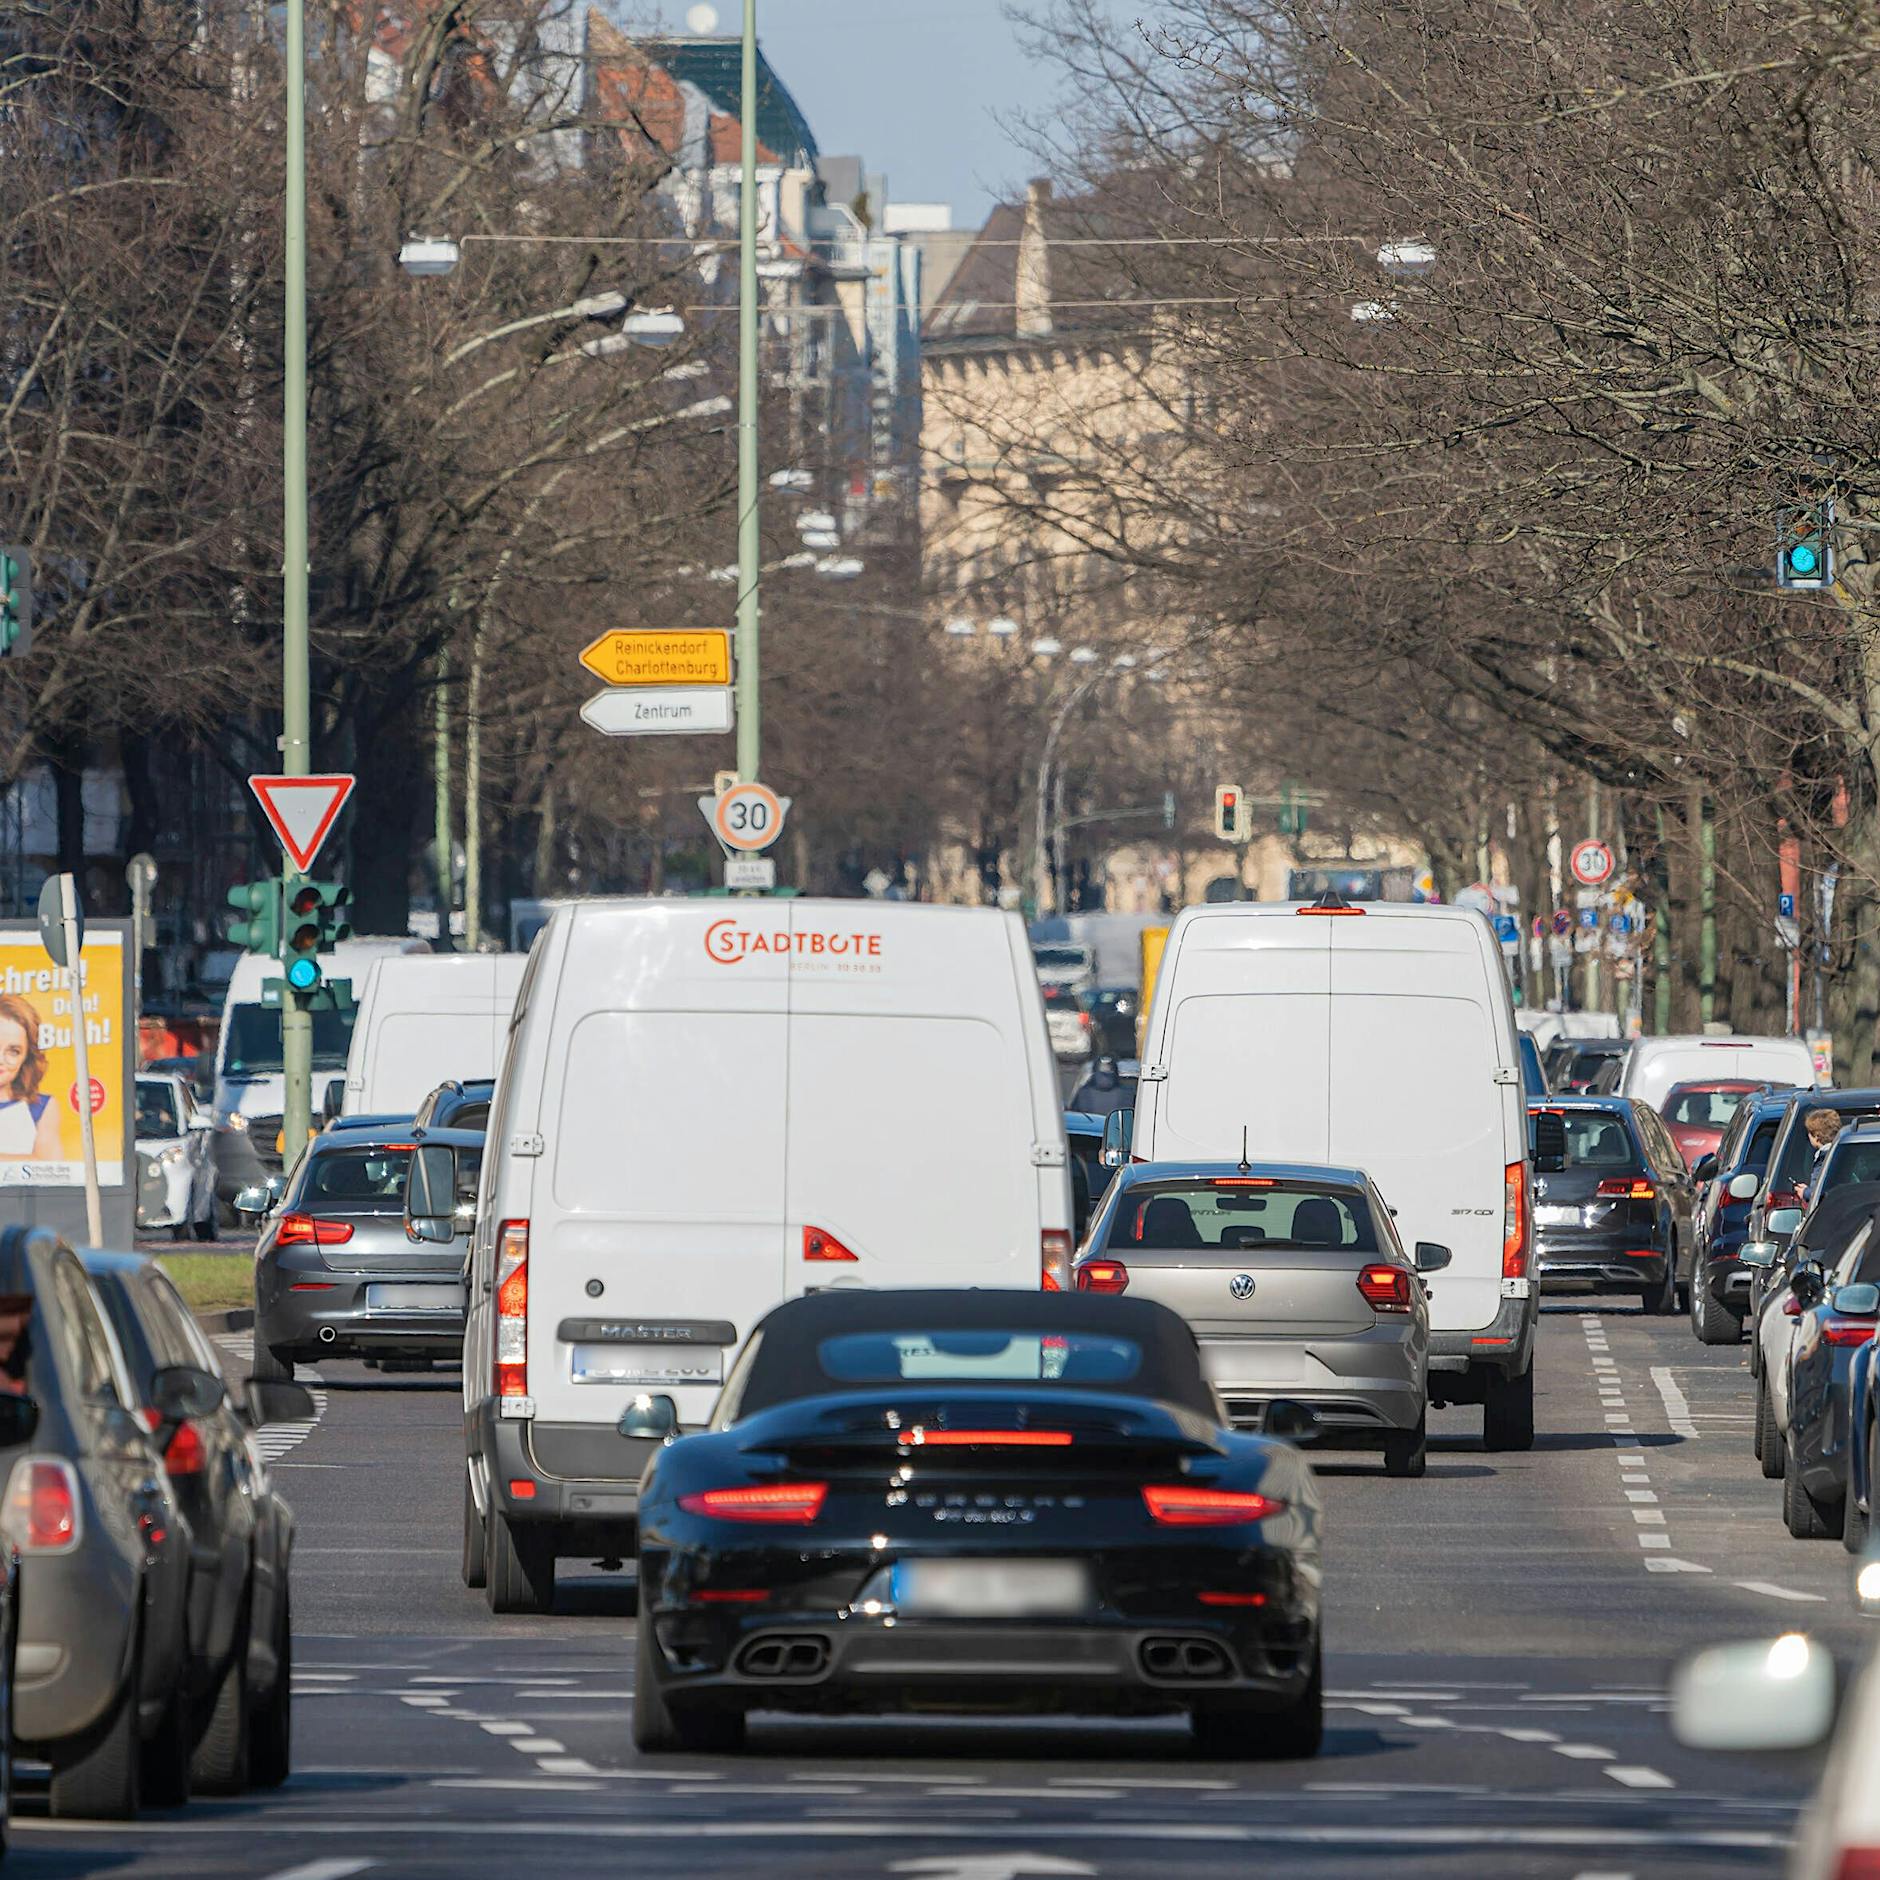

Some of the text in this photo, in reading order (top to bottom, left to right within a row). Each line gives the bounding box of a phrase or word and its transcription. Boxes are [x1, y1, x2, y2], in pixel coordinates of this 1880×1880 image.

[615, 640, 708, 655] Reinickendorf
[615, 660, 718, 677] Charlottenburg
[634, 703, 692, 719] Zentrum
[731, 802, 766, 830] 30
[1581, 851, 1605, 871] 30
[38, 1018, 110, 1049] Buh!
[601, 1325, 691, 1339] MASTER
